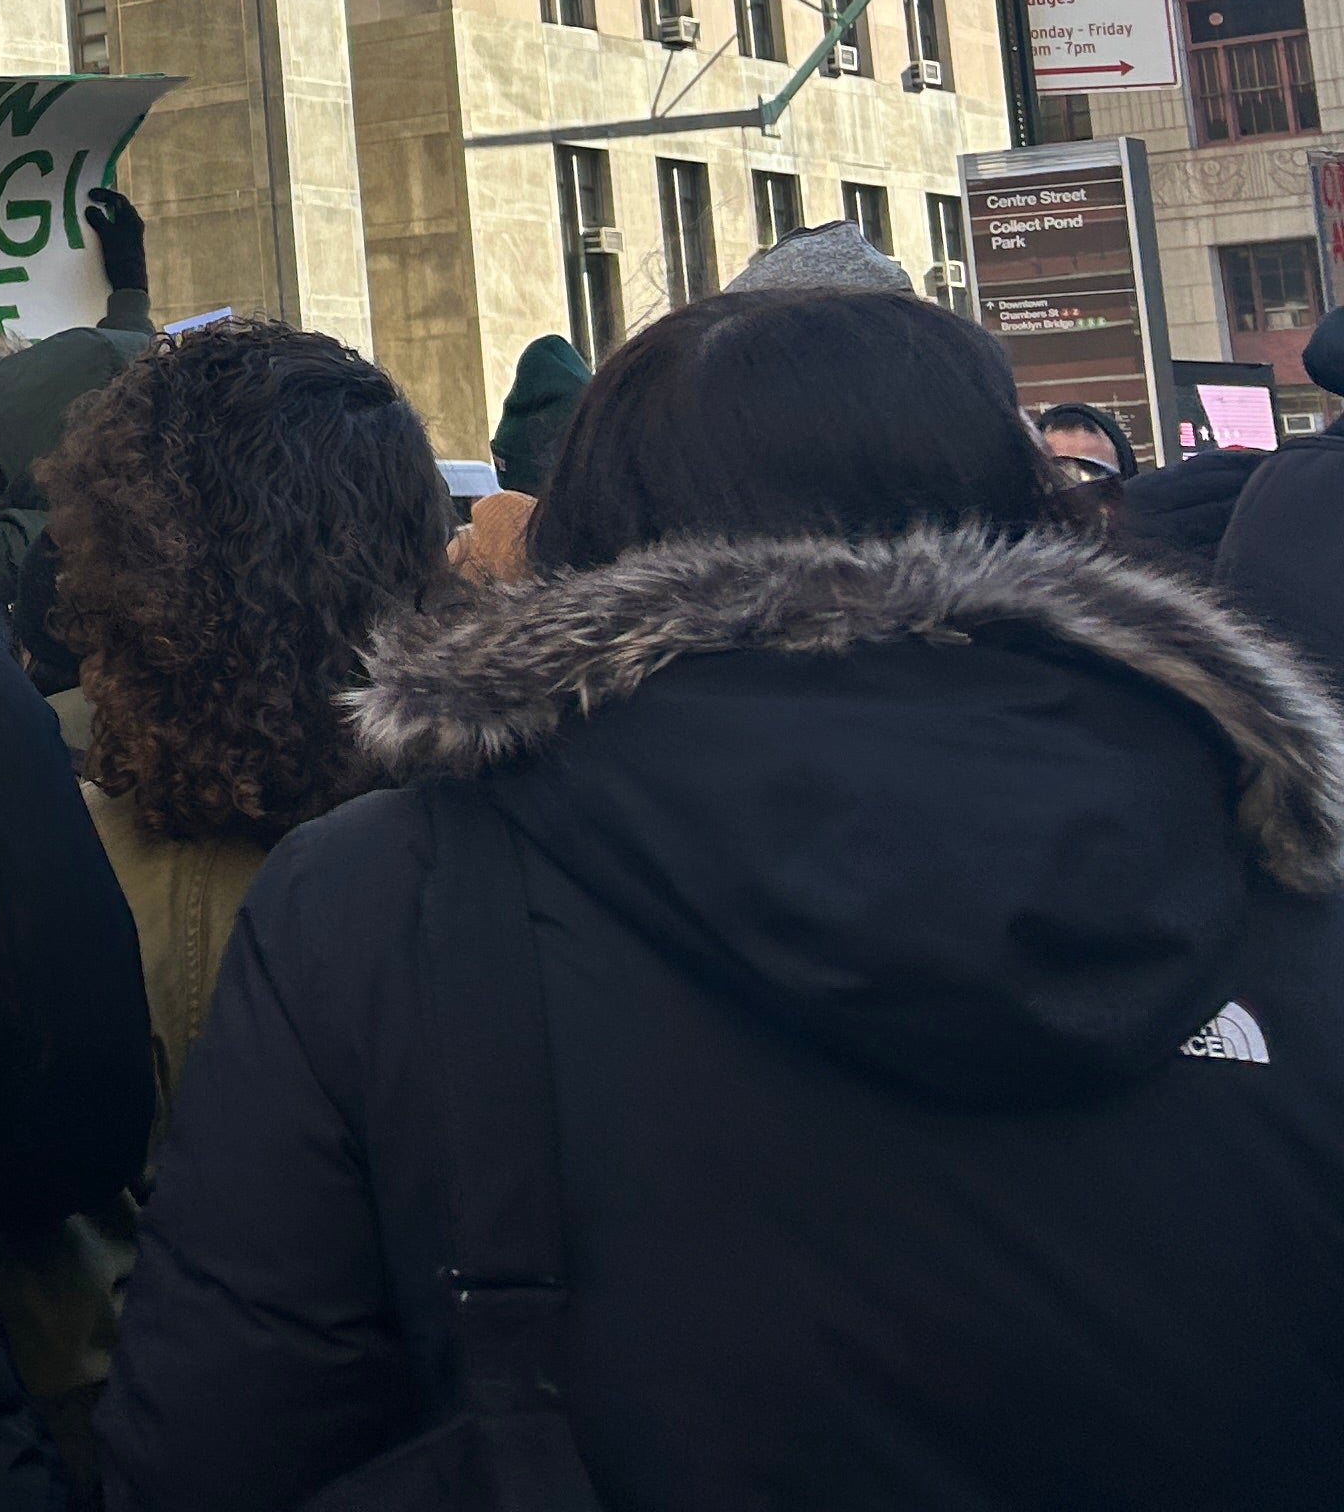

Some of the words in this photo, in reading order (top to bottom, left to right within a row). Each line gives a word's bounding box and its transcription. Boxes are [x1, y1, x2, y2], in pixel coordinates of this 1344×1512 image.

[1031, 26, 1073, 39] onday
[1088, 23, 1132, 37] Friday
[1031, 45, 1051, 56] am
[1065, 41, 1096, 57] 7pm
[986, 193, 1037, 209] Centre
[1040, 188, 1087, 205] Street
[989, 219, 1041, 235] Collect
[1043, 214, 1083, 231] Pond
[991, 235, 1026, 250] Park
[998, 300, 1048, 310] Downtown
[999, 310, 1047, 321] Chambers
[1048, 308, 1060, 317] St
[1000, 320, 1042, 331] Brooklyn
[1043, 319, 1074, 330] Bridge
